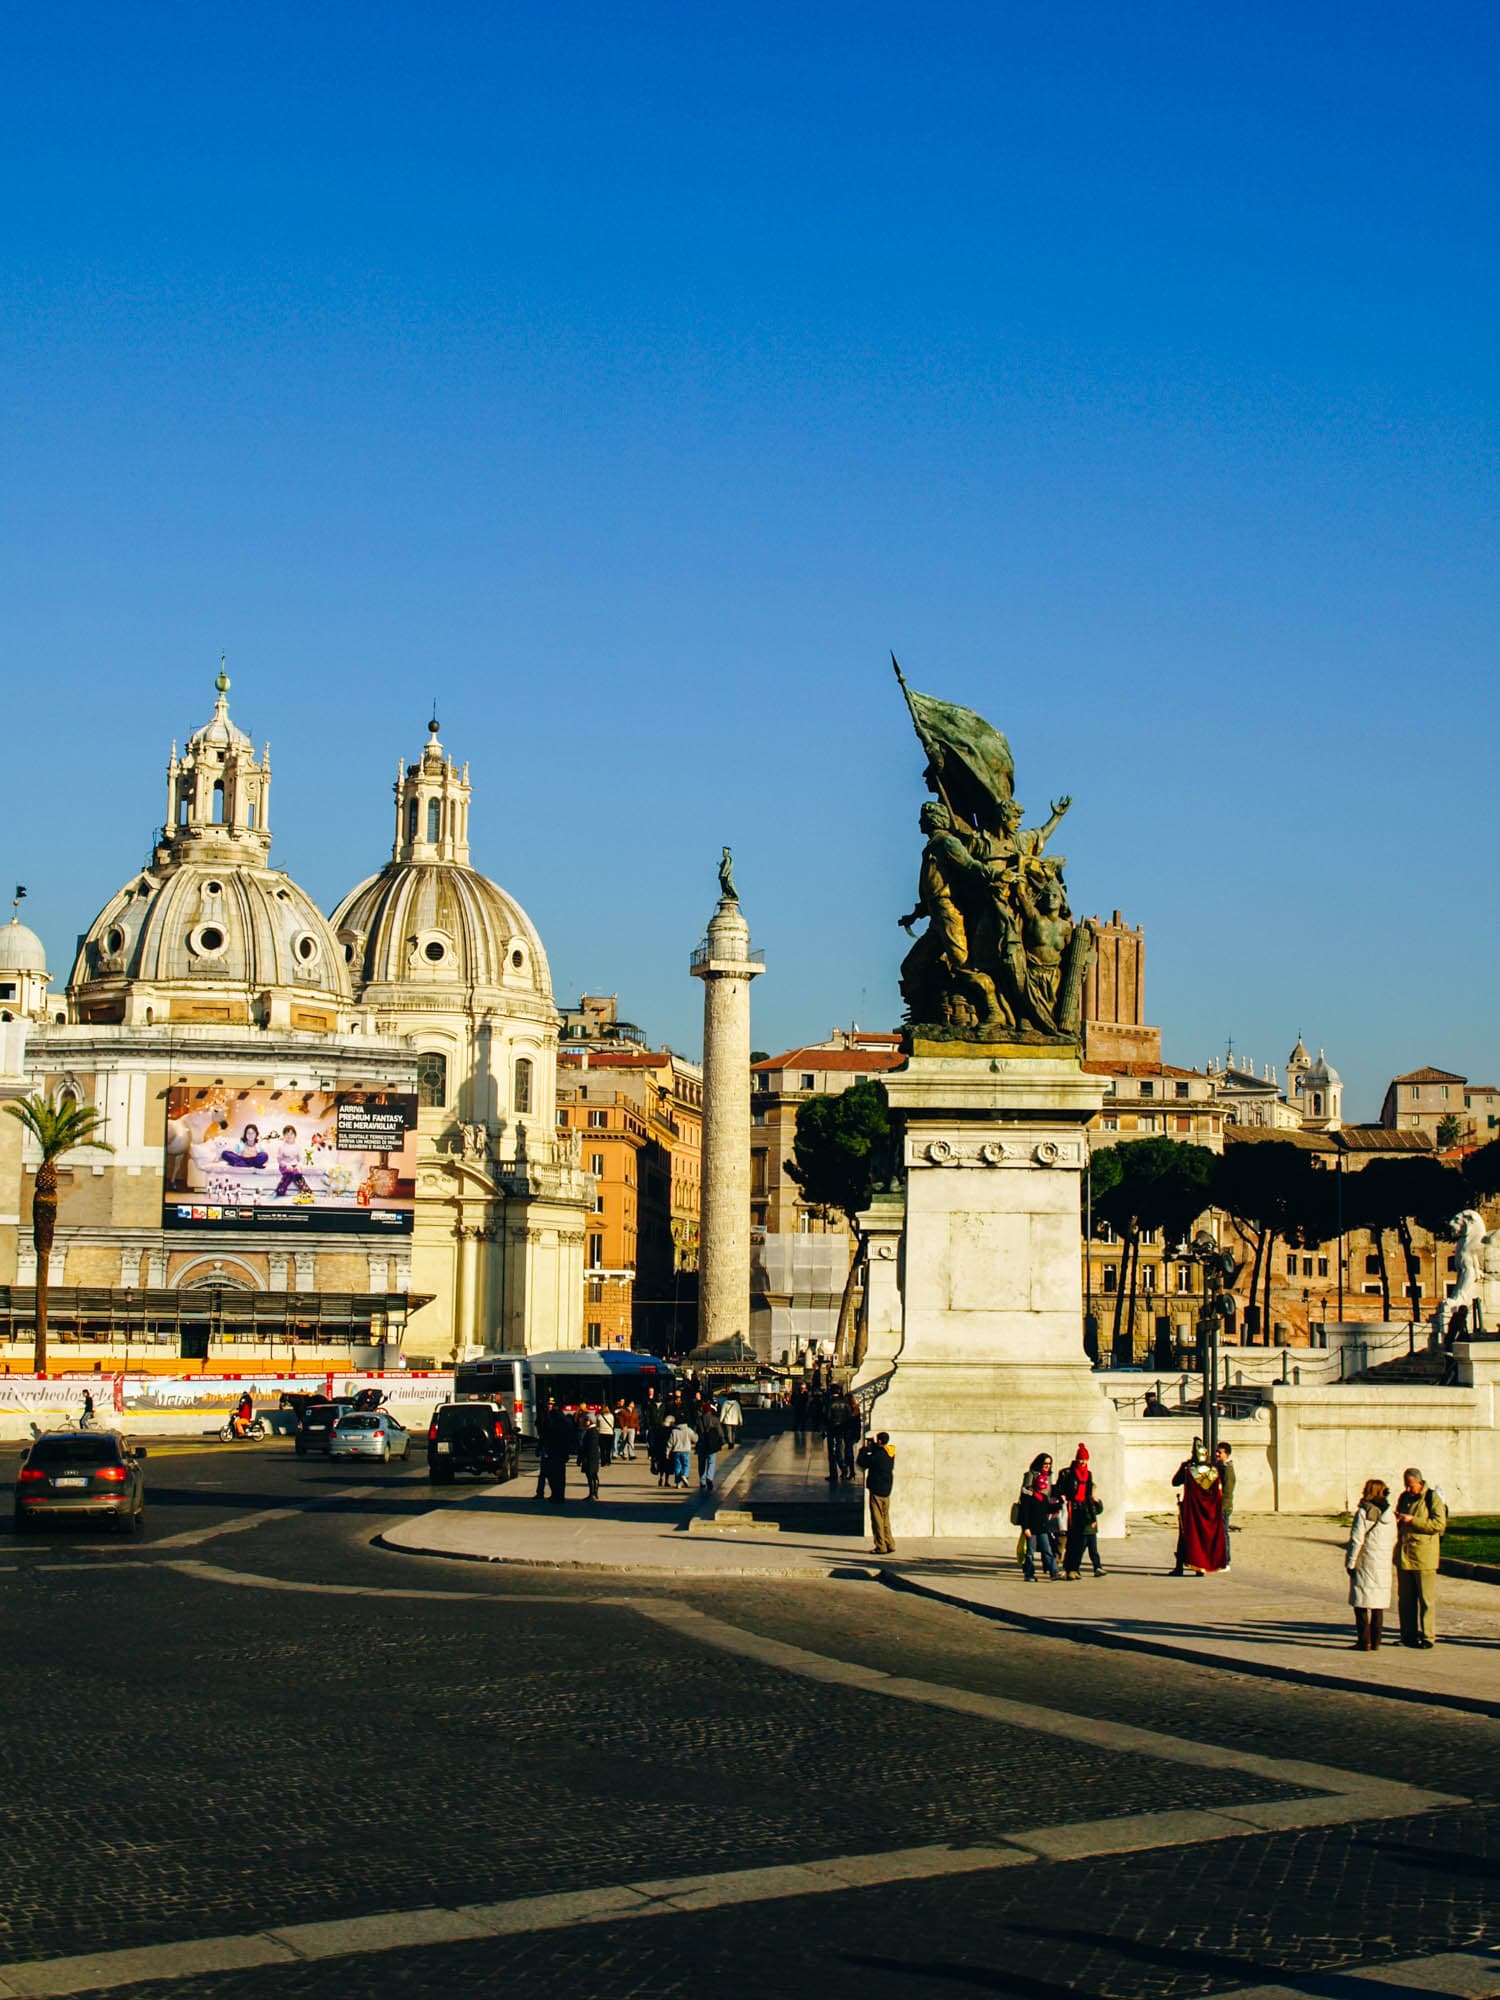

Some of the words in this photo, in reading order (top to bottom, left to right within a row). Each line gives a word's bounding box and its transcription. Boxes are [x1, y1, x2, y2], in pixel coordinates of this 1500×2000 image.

[339, 1105, 364, 1113] ARRIVA
[338, 1113, 371, 1121] PREMIUM
[372, 1114, 404, 1123] FANTASY,
[338, 1121, 353, 1129] CHE
[353, 1122, 397, 1130] MERAVIGLIA!
